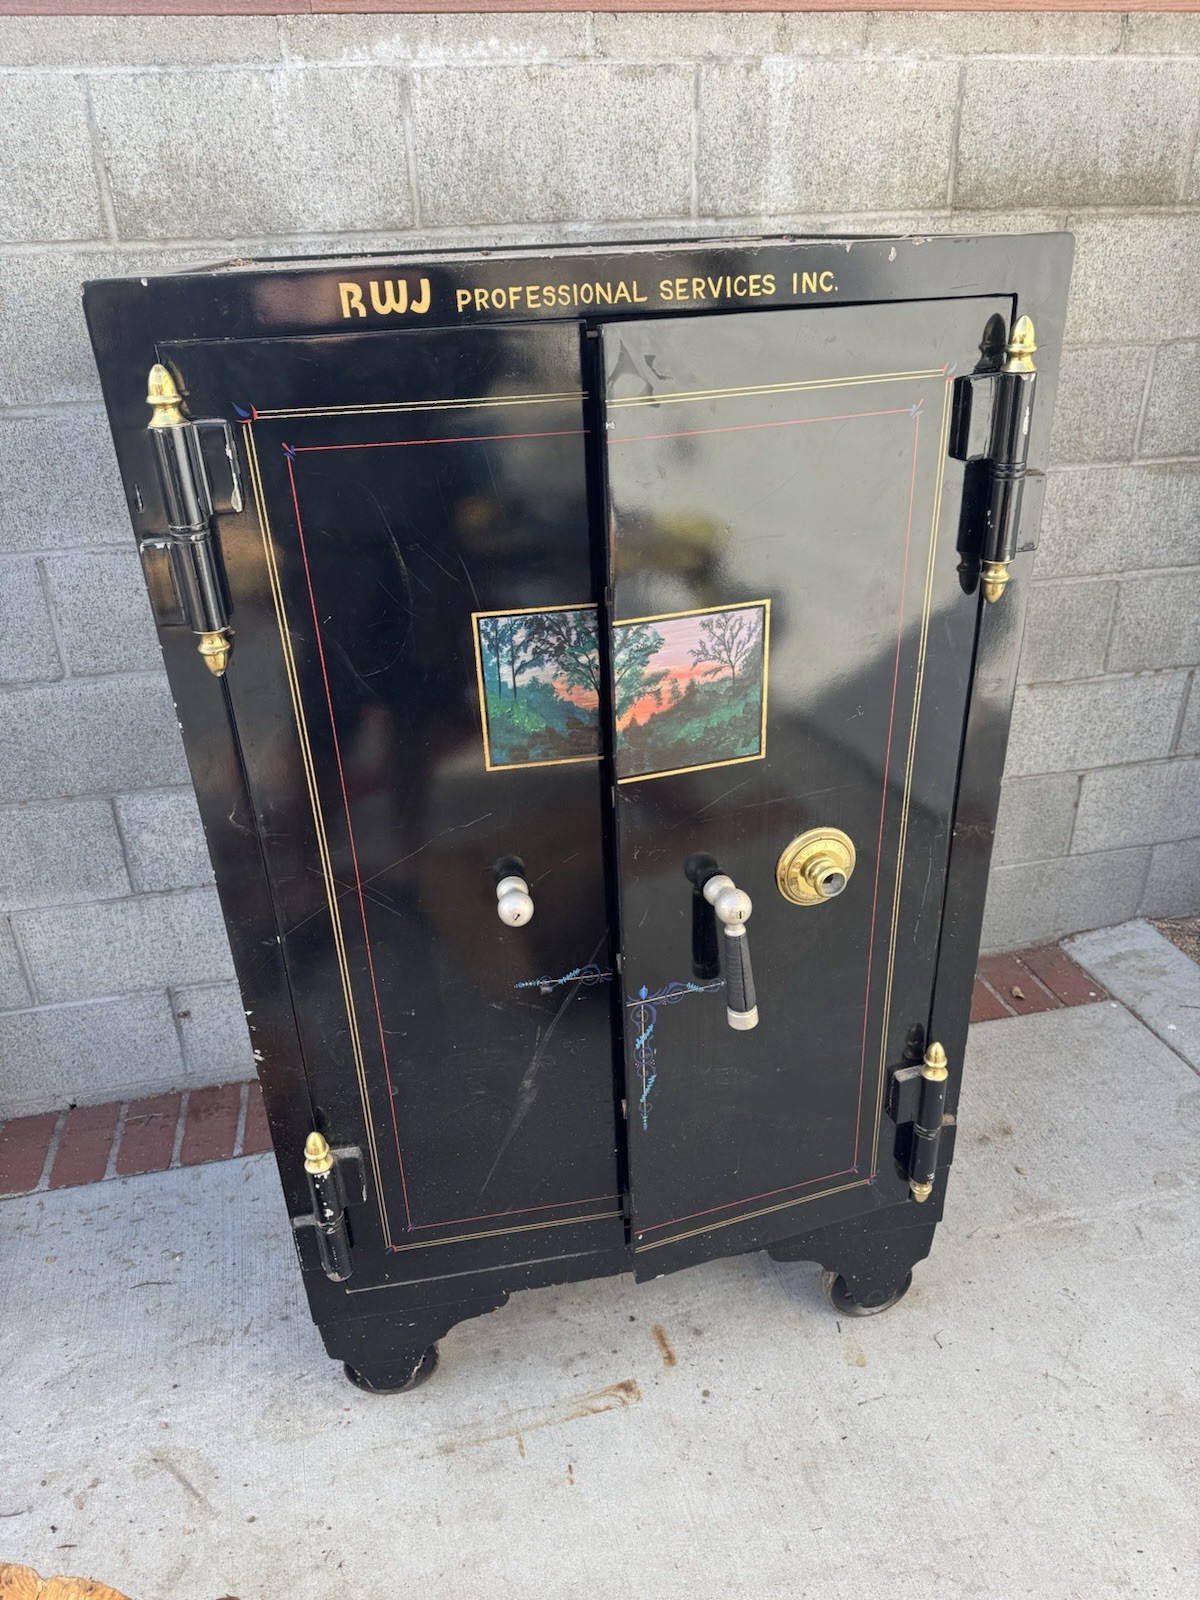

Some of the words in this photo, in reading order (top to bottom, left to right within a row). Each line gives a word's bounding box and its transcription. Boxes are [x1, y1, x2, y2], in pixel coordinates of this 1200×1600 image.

[337, 278, 432, 318] RWJ
[455, 280, 648, 313] PROFESSIONAL
[659, 273, 776, 302] SERVICES
[792, 271, 839, 295] INC.
